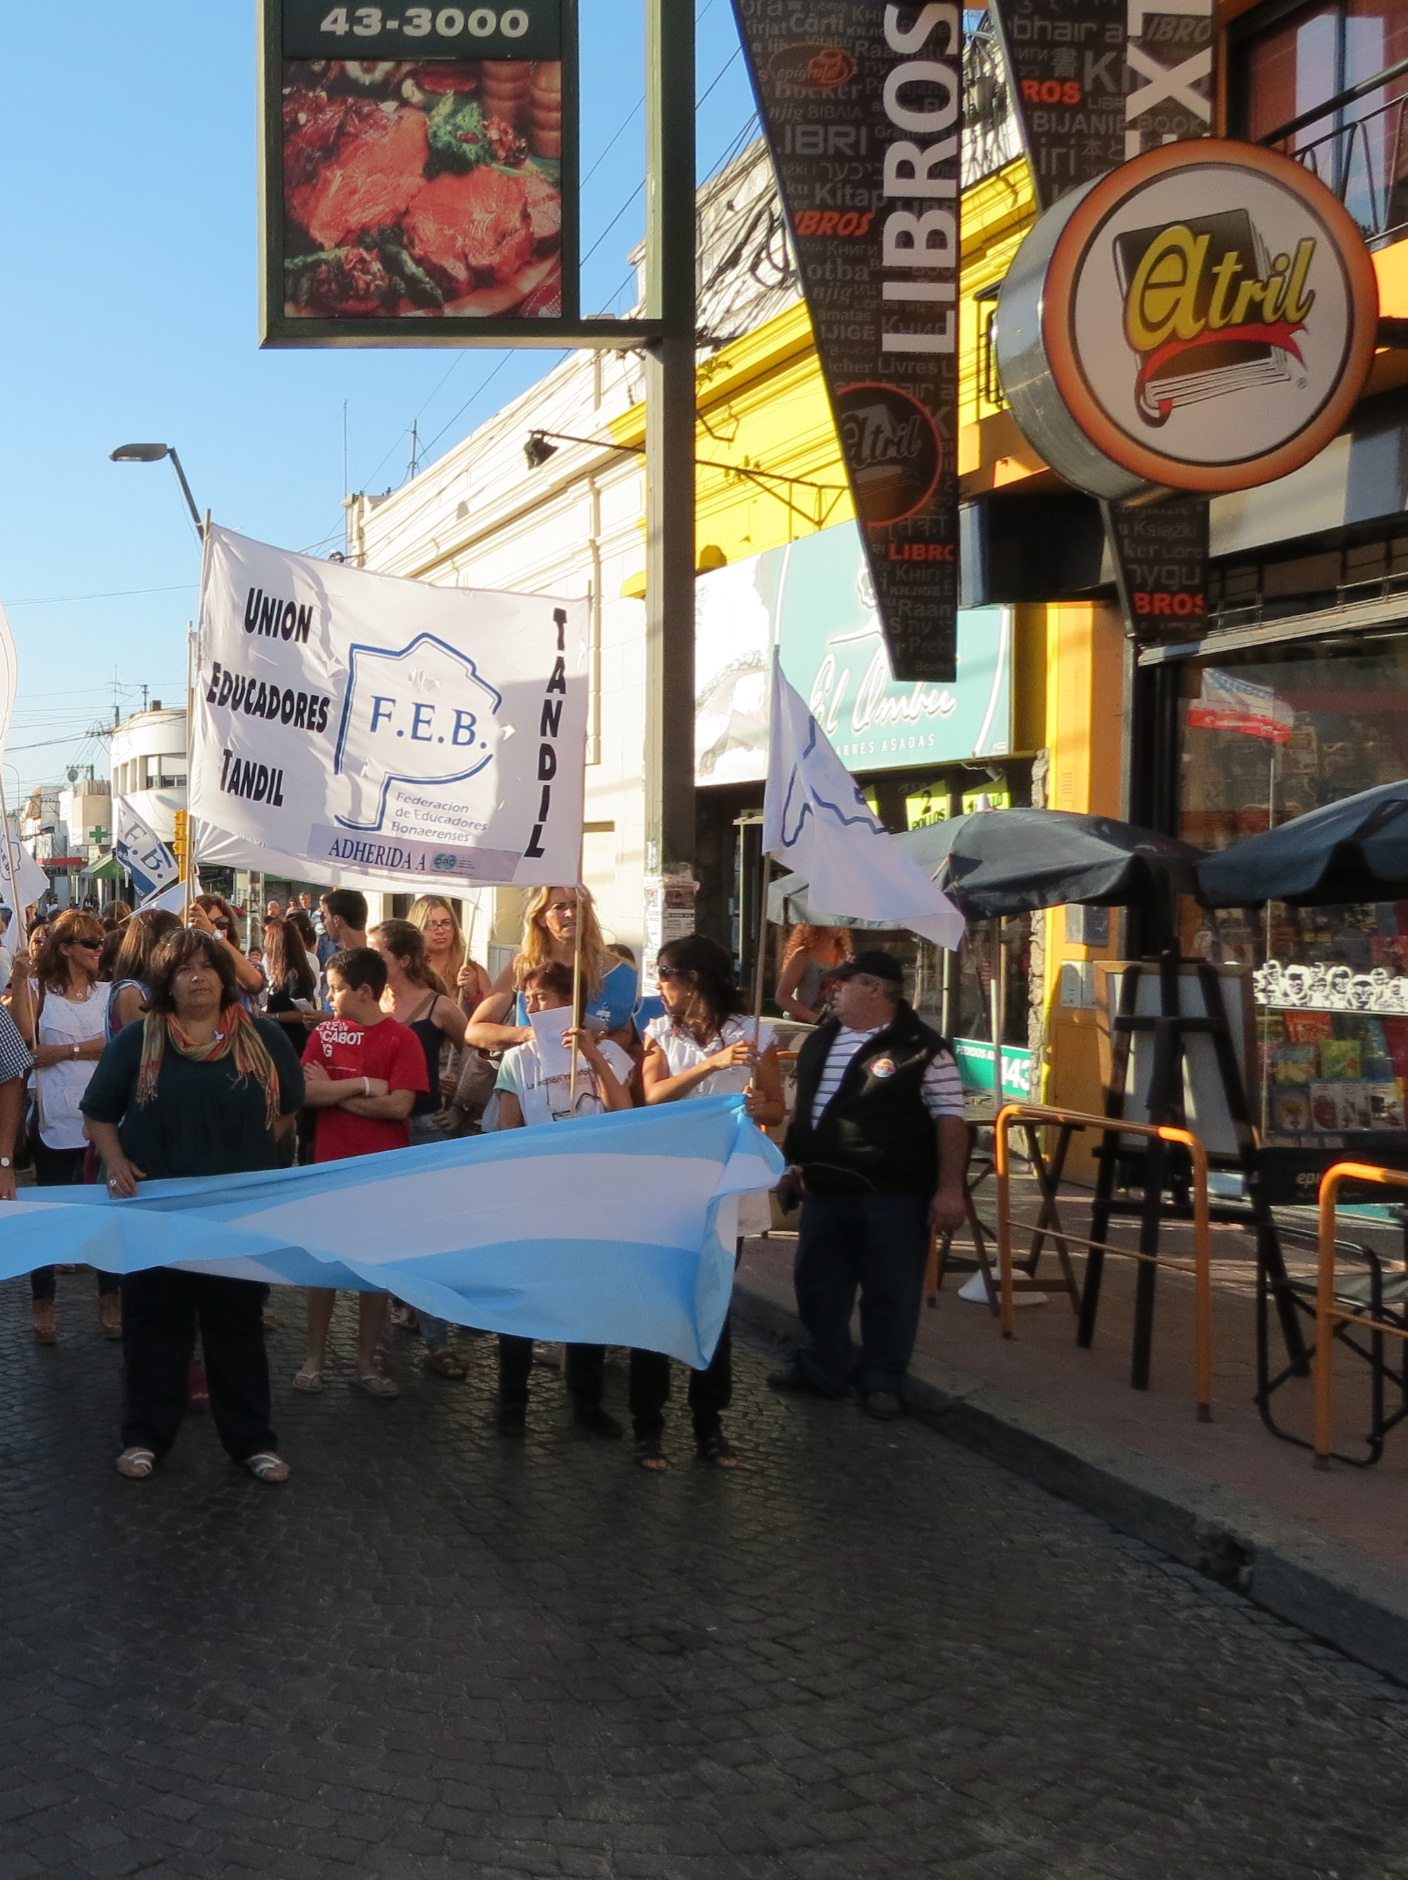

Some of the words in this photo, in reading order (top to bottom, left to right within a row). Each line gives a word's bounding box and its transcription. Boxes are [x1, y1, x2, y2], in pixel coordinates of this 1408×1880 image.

[320, 7, 530, 38] 43-3000
[881, 3, 959, 352] LIBROS
[244, 587, 314, 644] UNION
[206, 661, 331, 734] EDUCADORES
[370, 695, 488, 751] F.E.B.
[523, 607, 568, 859] TANDIL
[880, 733, 937, 753] ASADAS
[220, 748, 285, 808] TANDIL
[395, 807, 411, 819] de
[414, 809, 489, 832] Educadores
[921, 789, 933, 816] 2
[328, 837, 412, 871] ADHERIDA
[415, 852, 427, 872] A
[392, 821, 470, 843] Bonaerenses
